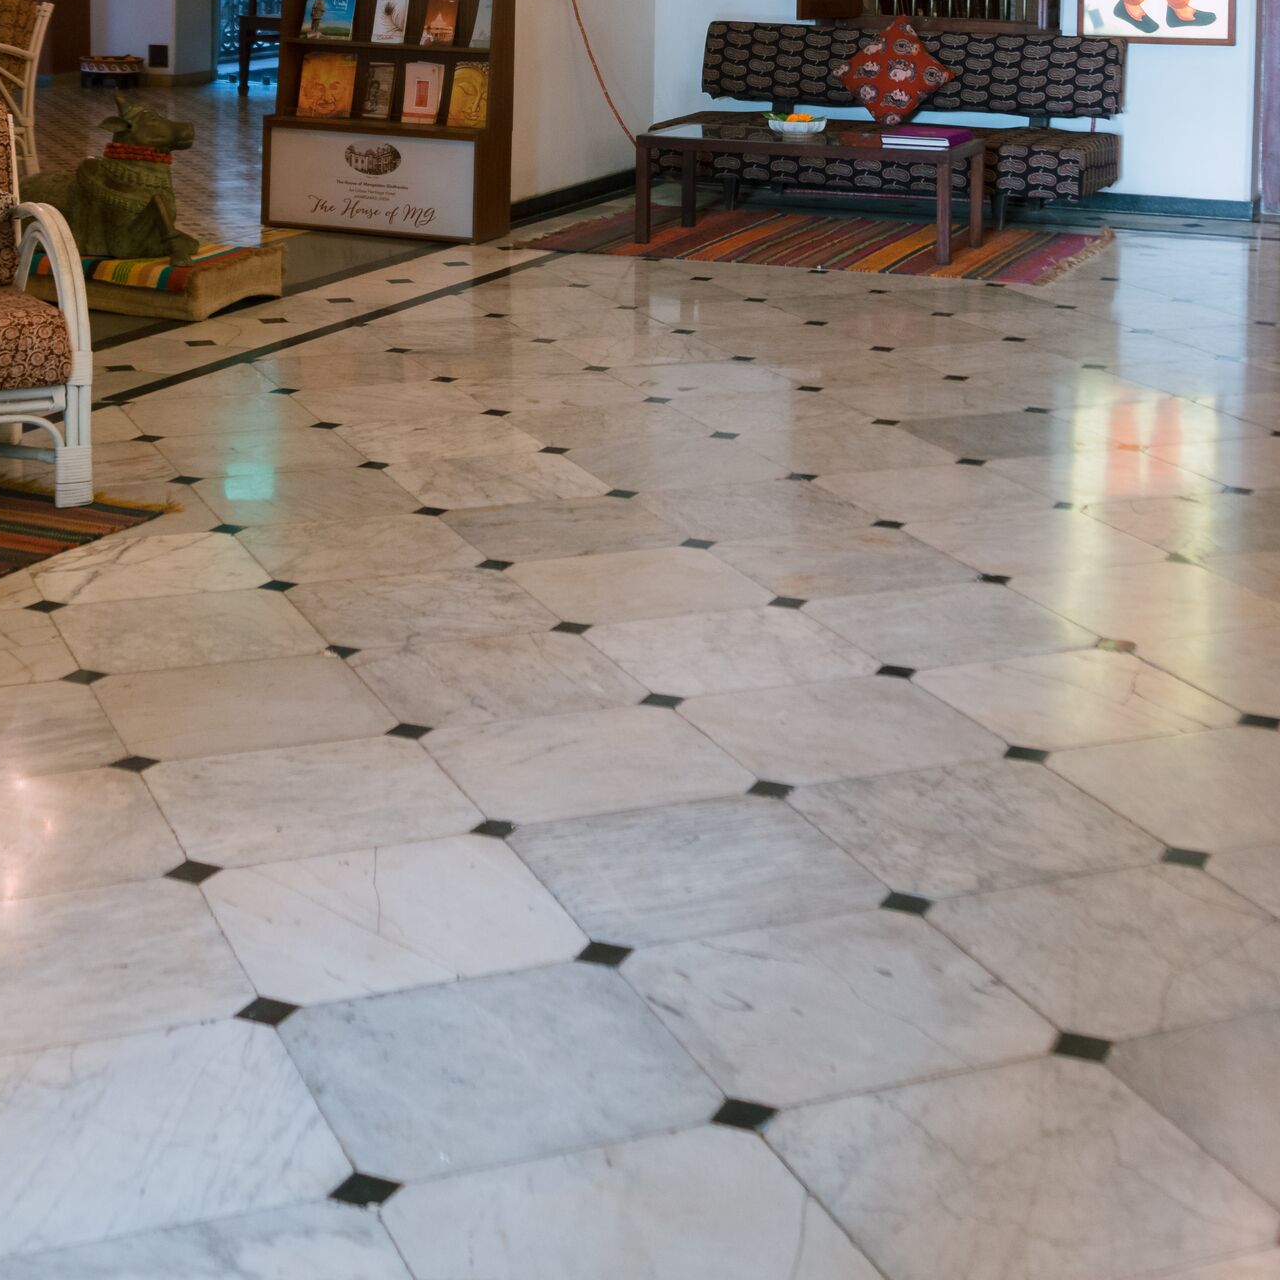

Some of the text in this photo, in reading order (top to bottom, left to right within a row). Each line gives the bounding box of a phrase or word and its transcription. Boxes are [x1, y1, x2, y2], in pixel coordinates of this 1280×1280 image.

[308, 194, 437, 228] The House of MG
